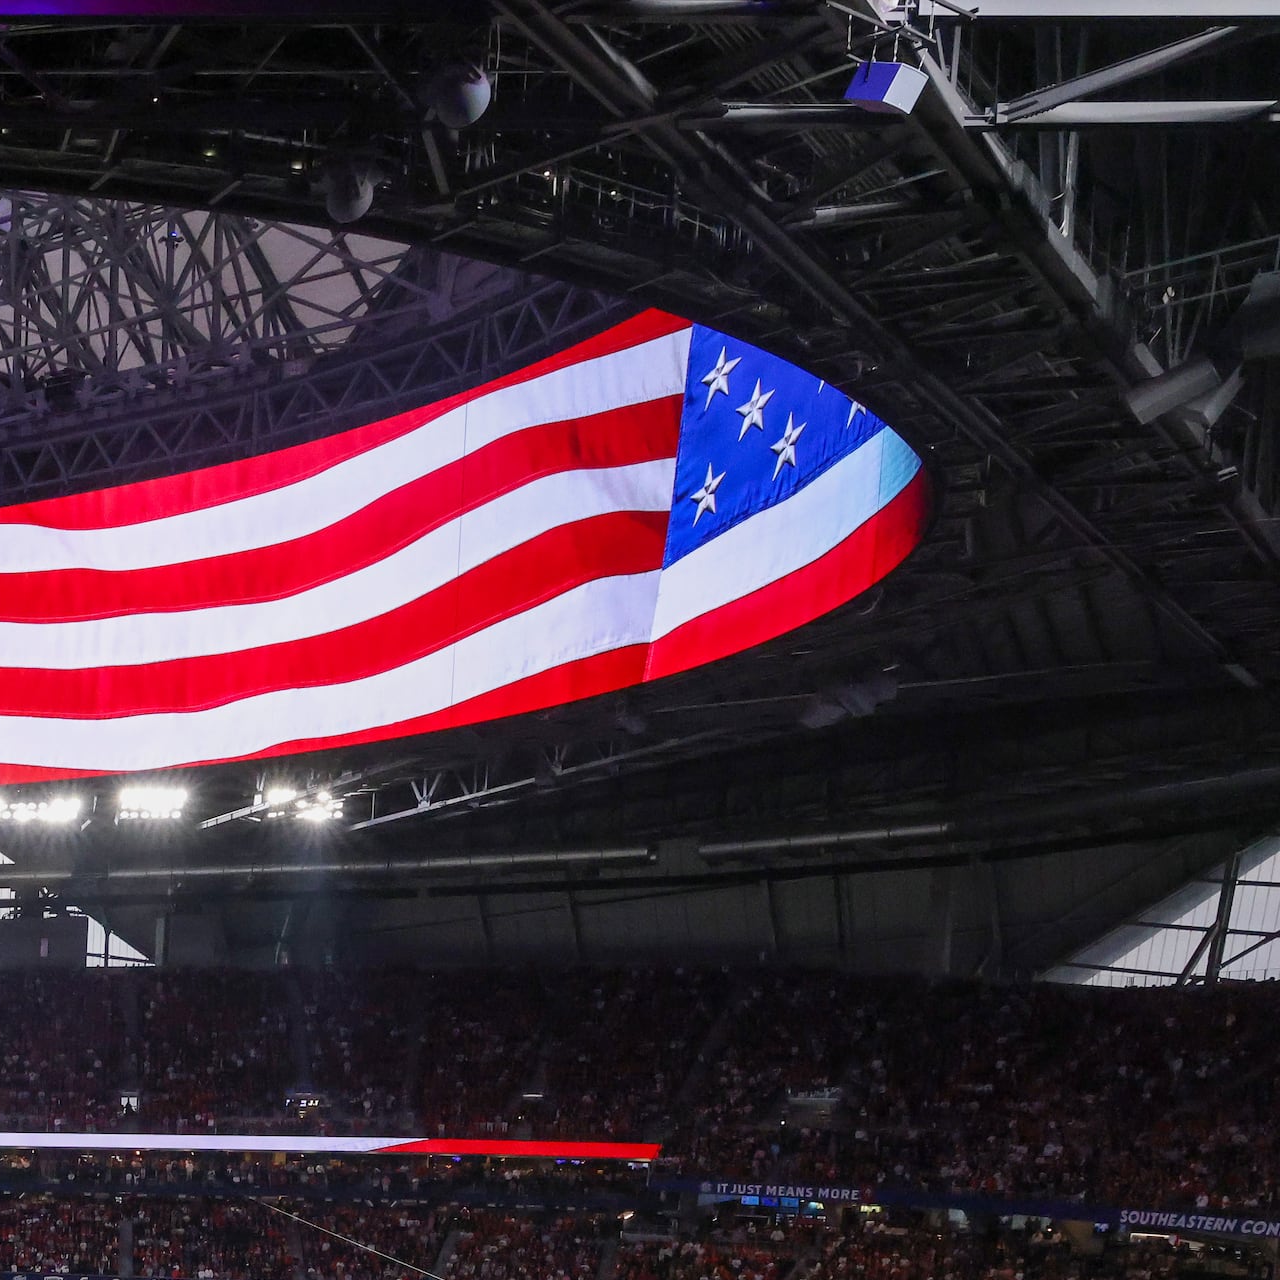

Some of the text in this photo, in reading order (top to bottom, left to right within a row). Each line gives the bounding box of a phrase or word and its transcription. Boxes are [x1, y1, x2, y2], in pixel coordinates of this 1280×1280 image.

[717, 1183, 728, 1193] IT
[731, 1184, 761, 1195] JUST
[766, 1186, 813, 1198] MEANS
[1120, 1209, 1237, 1232] SOUTHEASTERN
